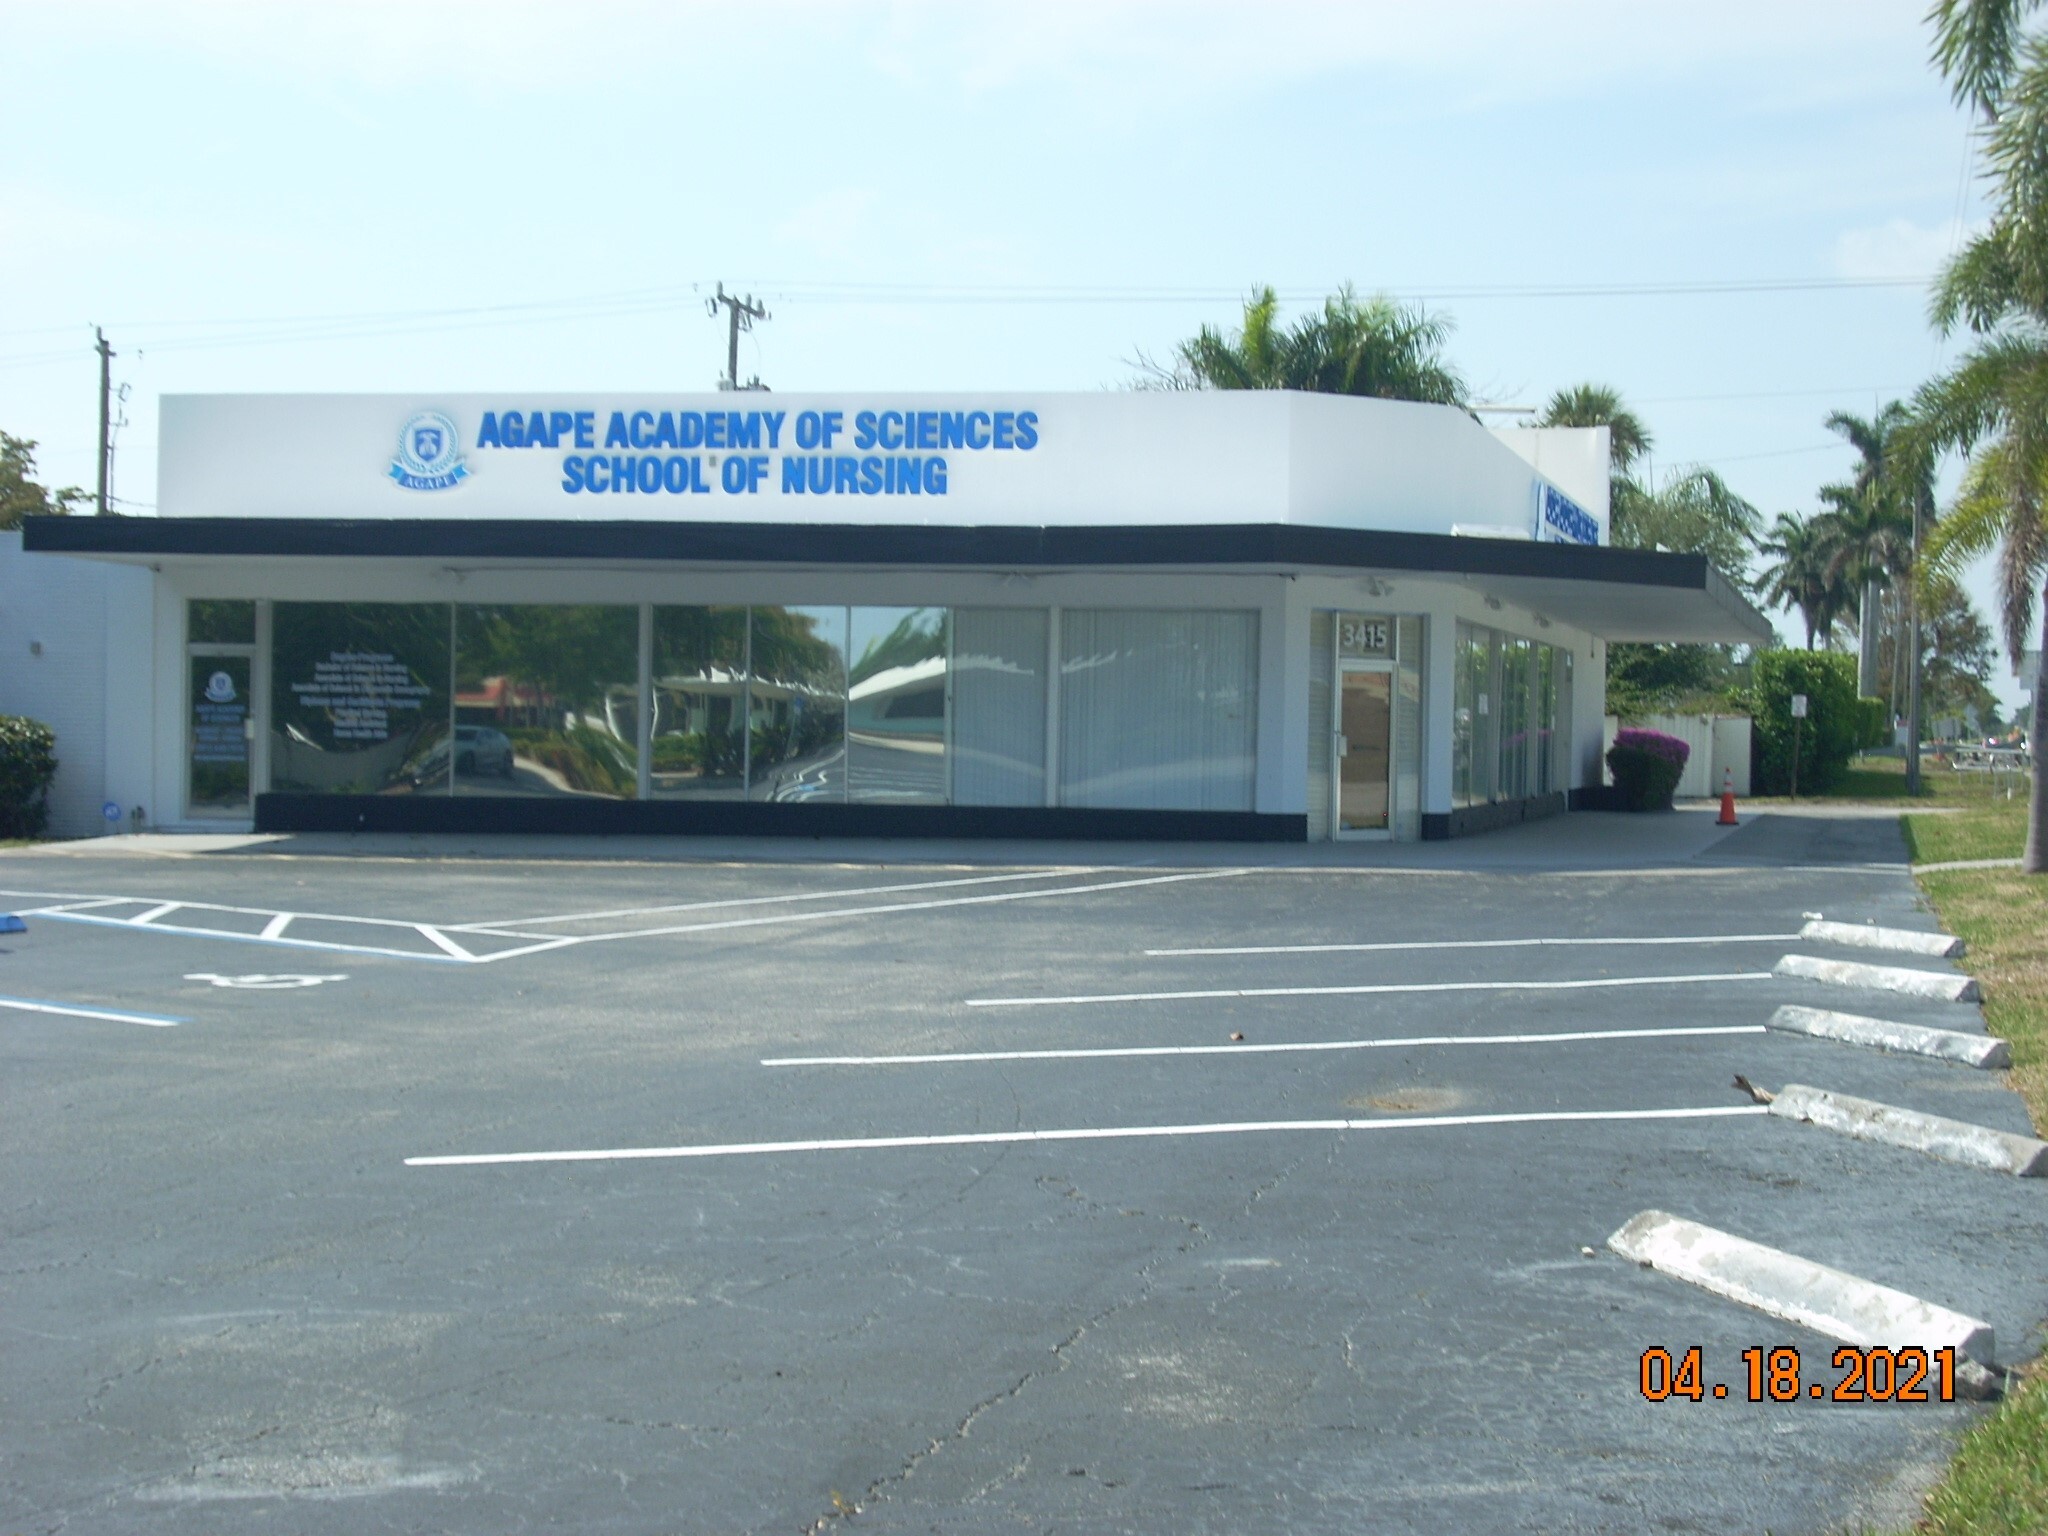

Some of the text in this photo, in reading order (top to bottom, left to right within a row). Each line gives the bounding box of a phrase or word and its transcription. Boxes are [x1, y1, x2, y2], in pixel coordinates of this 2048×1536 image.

[476, 410, 1039, 451] AGAPE ACADEMY OF SCIENCES
[403, 475, 453, 490] AGAPE
[560, 455, 948, 495] SCHOOL OF NURSING
[1342, 623, 1388, 649] 3415
